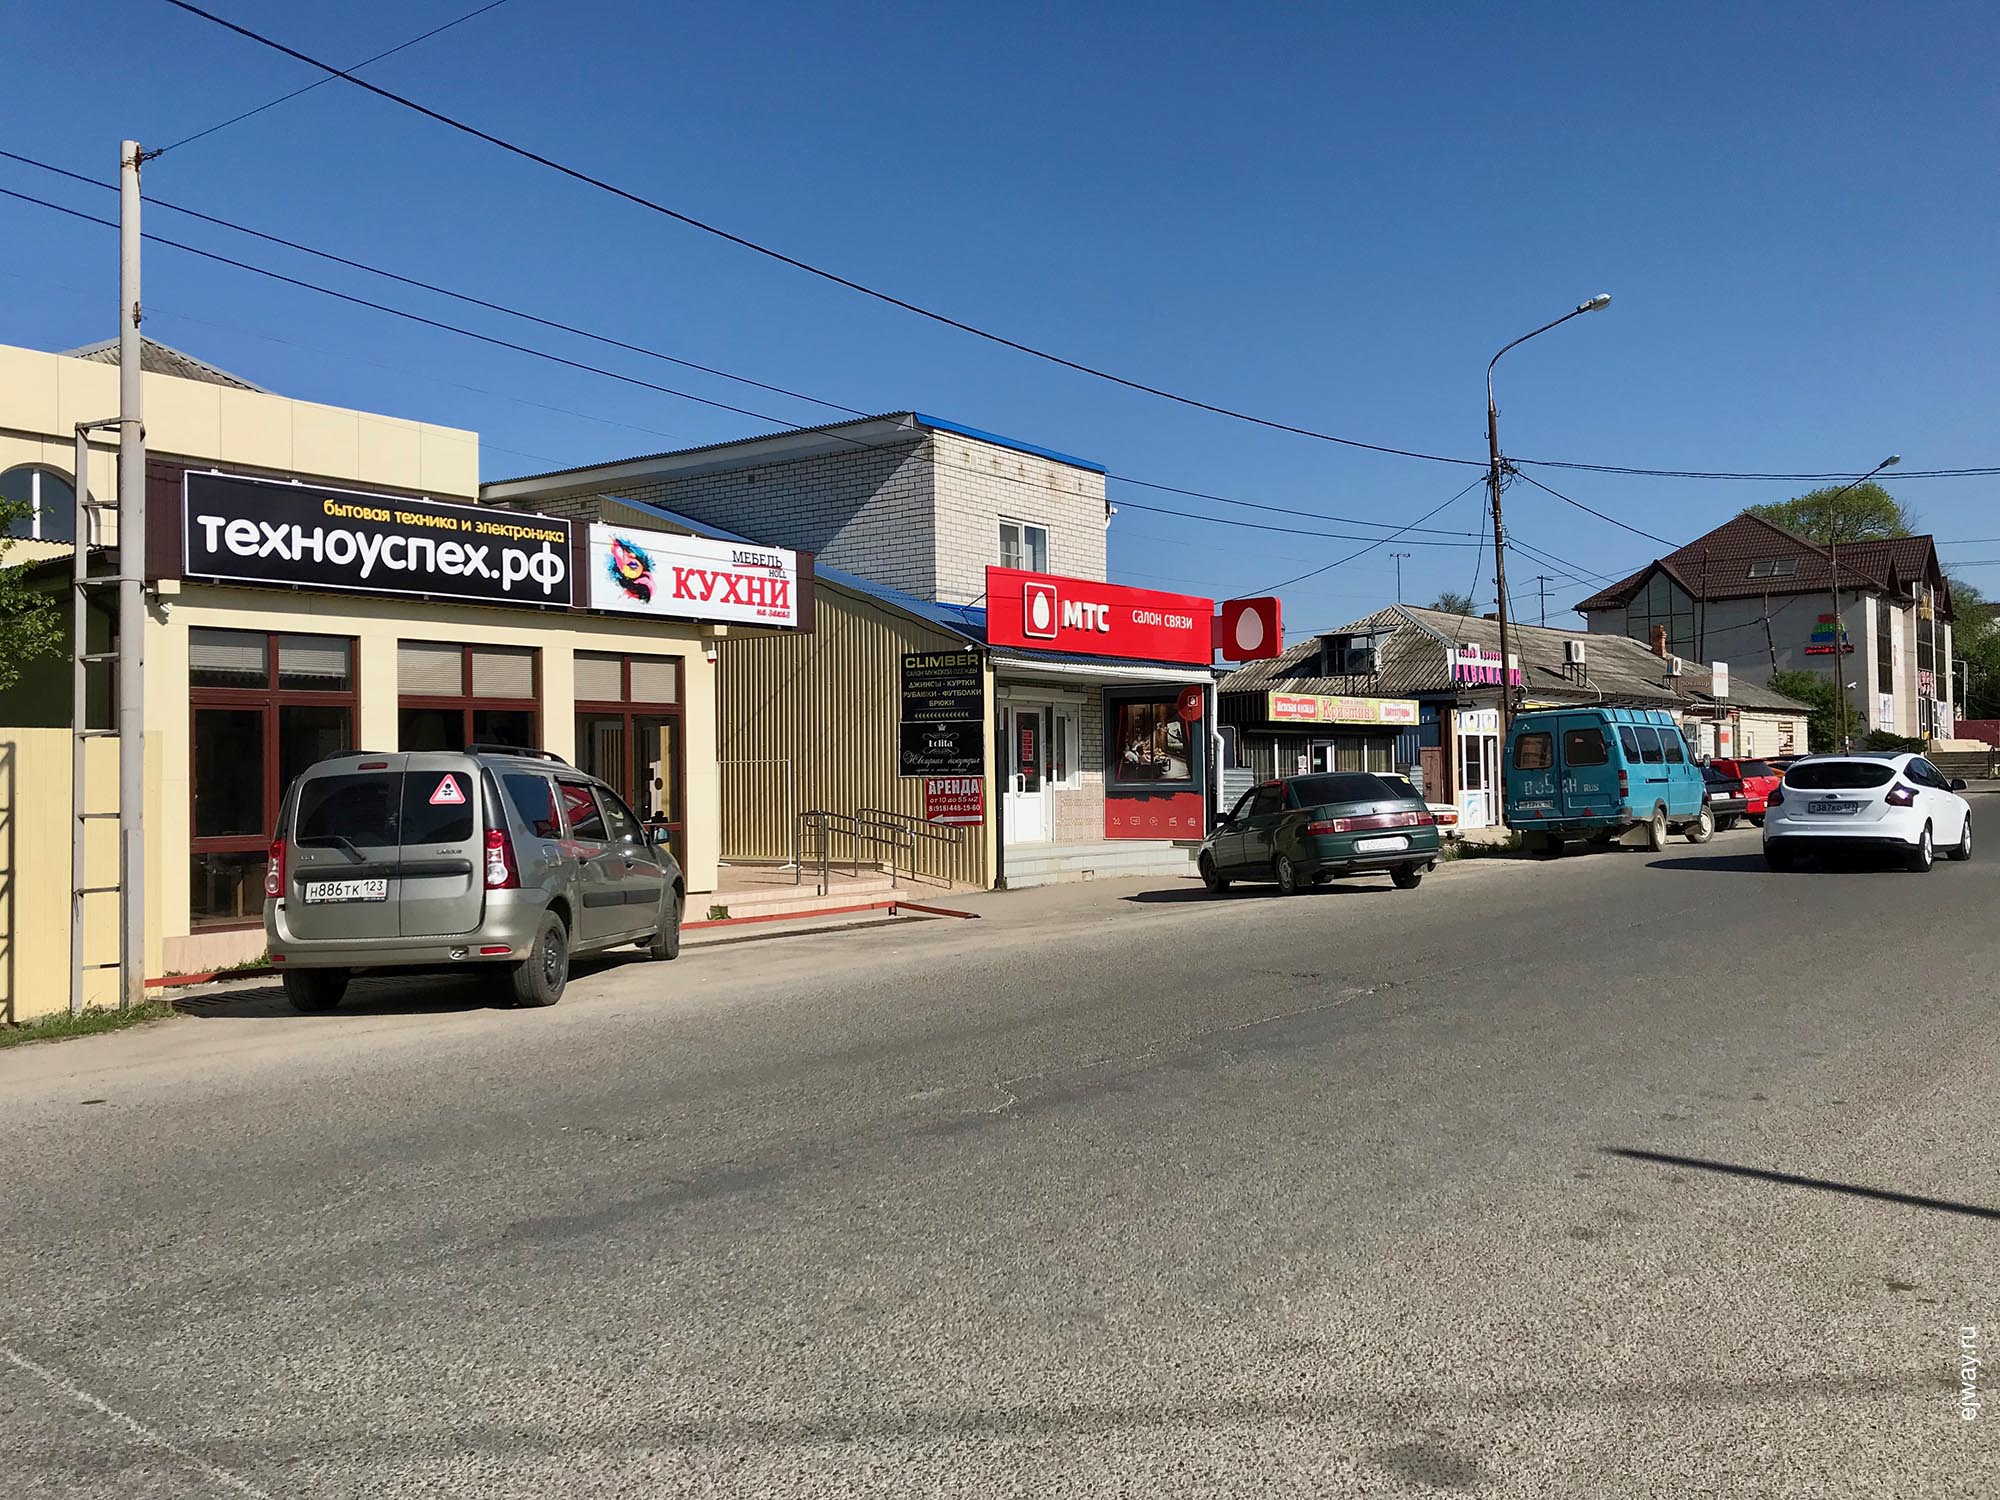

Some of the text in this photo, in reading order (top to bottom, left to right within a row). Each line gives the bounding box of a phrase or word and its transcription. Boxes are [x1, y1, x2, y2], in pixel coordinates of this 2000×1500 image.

[323, 499, 565, 543] бытовая техника и электроника
[196, 515, 565, 595] техноуспех.рф
[732, 550, 782, 568] МЕБЕЛЬ
[672, 566, 790, 609] КУХНИ
[768, 610, 790, 619] заказ
[1063, 599, 1110, 632] МТС
[1132, 609, 1193, 630] салон связи
[905, 654, 979, 669] CLIMBER
[1455, 664, 1521, 686] АКВАМАИН
[908, 679, 976, 689] ДЖИНСЫ КУРТКИ
[942, 689, 982, 697] ФУТБОЛКИ
[929, 699, 955, 707] БРЮКИ
[928, 779, 980, 796] АРЕНДА
[310, 881, 383, 897] Н886ТК 123
